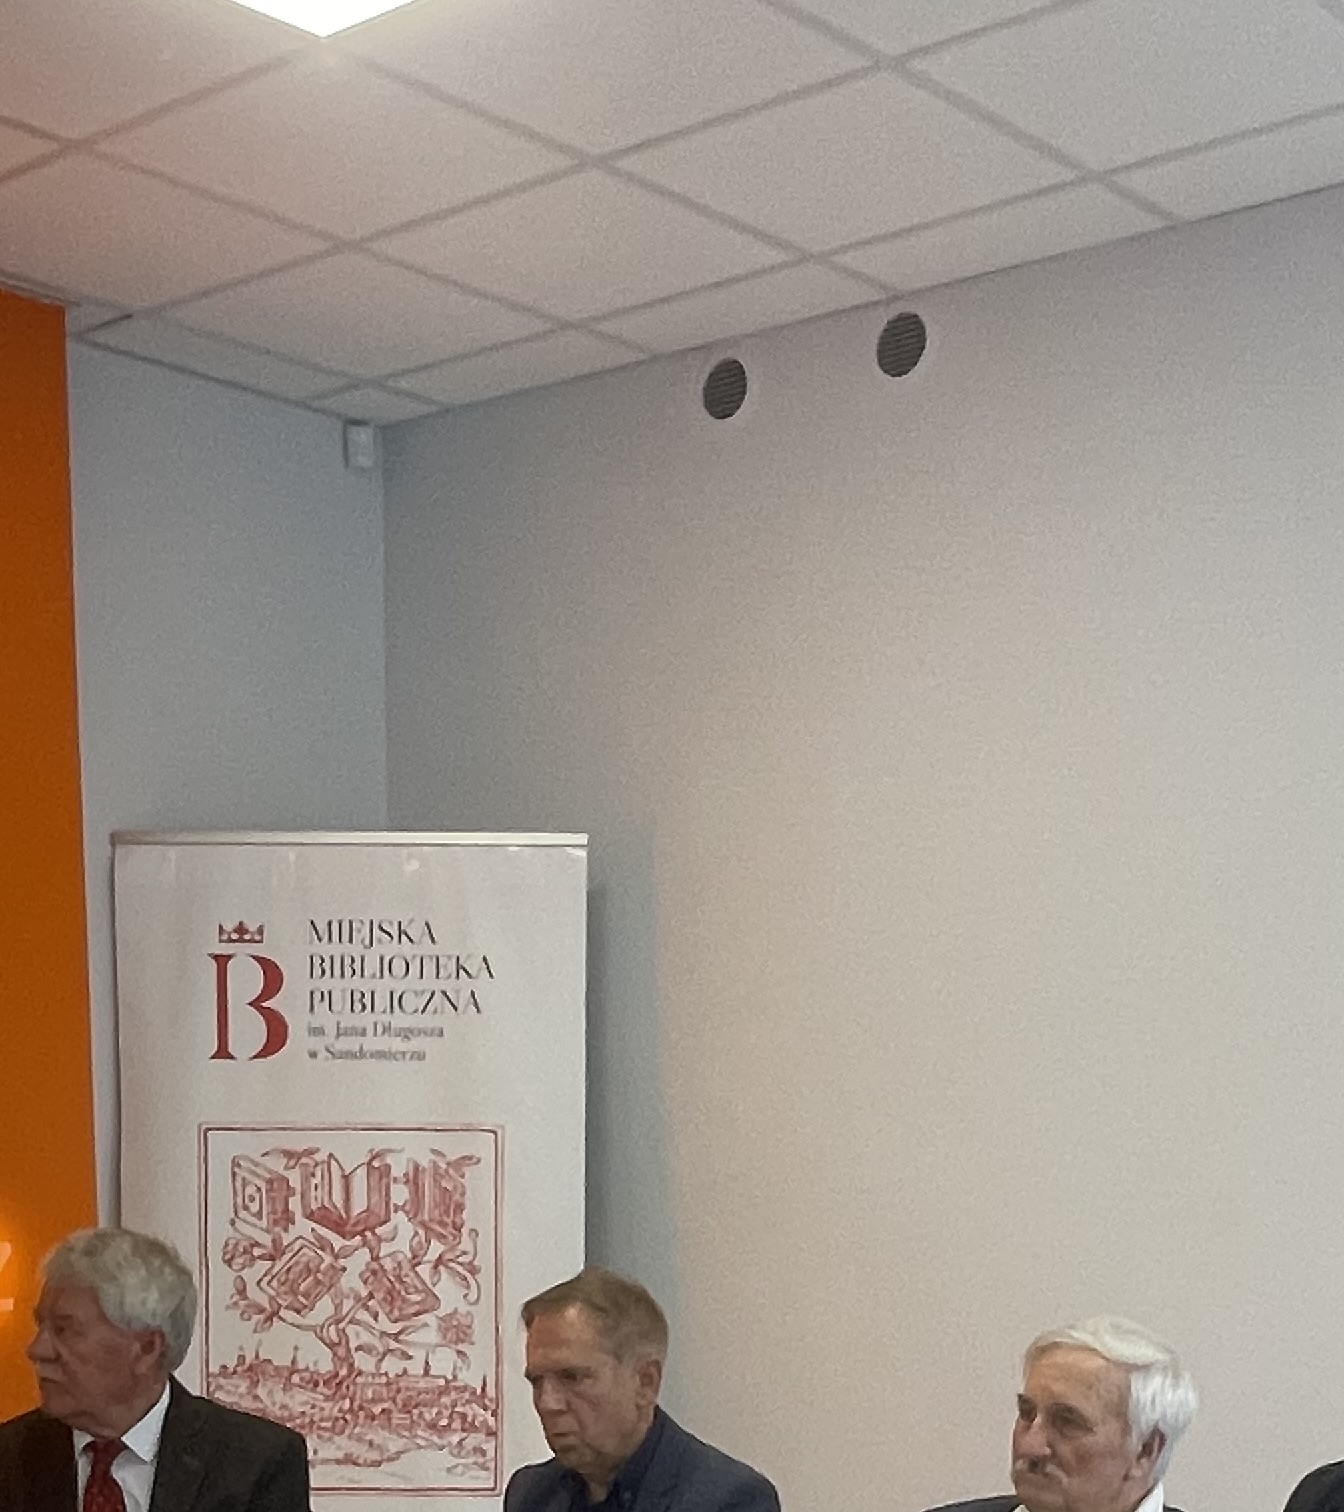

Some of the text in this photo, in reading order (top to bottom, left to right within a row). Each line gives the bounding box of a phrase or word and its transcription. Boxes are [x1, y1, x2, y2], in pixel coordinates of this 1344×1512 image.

[308, 918, 437, 949] MIEJSKA
[308, 954, 495, 980] BIBLIOTEKA
[308, 988, 482, 1016] PUBLICZNA
[334, 1020, 368, 1041] Jana
[373, 1020, 444, 1042] Długosza
[324, 1042, 427, 1062] Sandomierzu
